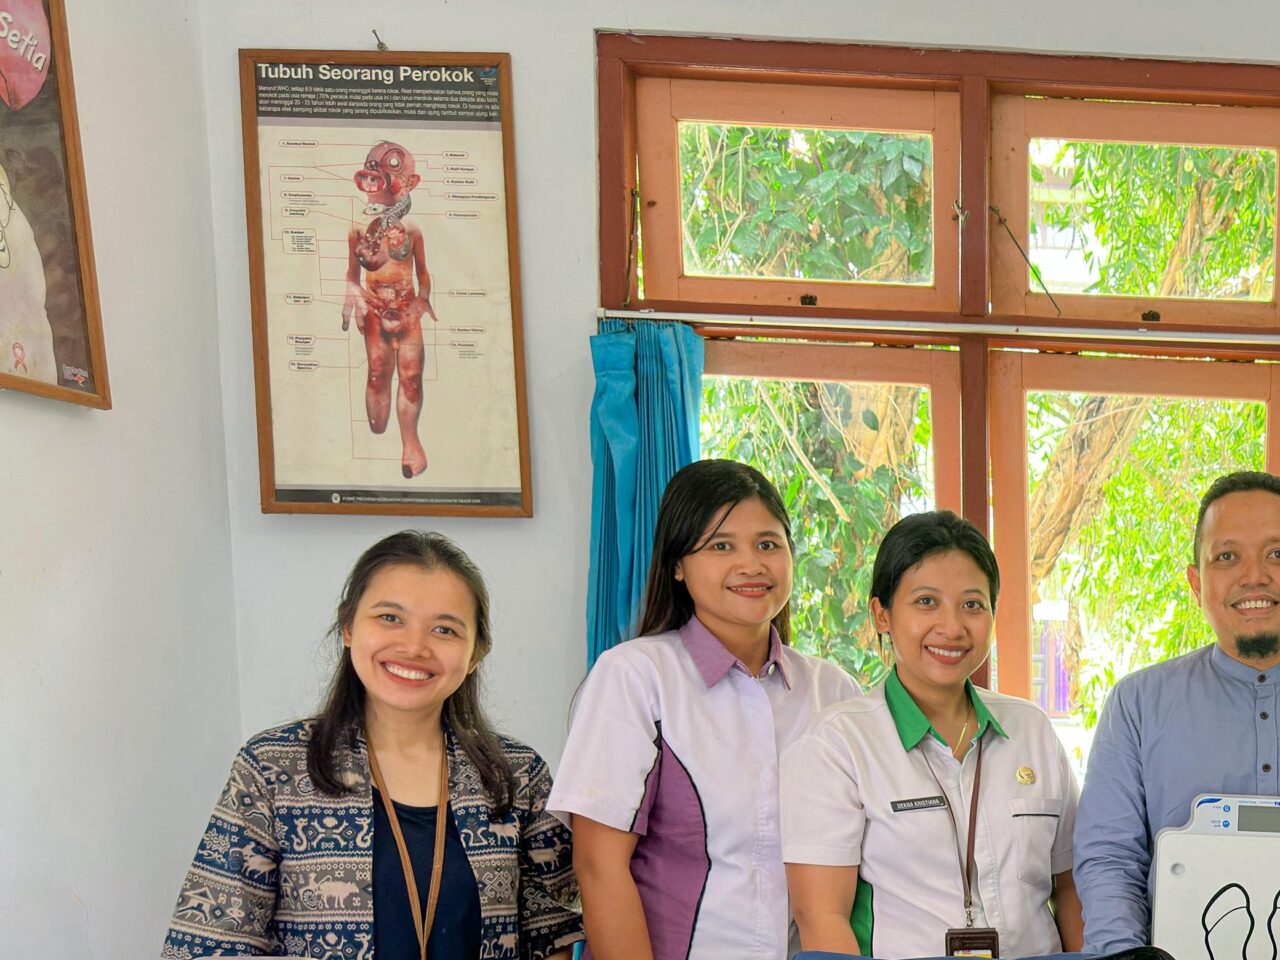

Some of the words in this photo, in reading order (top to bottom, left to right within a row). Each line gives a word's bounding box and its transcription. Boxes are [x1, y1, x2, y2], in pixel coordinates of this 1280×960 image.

[0, 11, 47, 72] Setia
[257, 63, 314, 80] Tubuh
[318, 64, 394, 85] Seorang
[399, 66, 475, 83] Perokok
